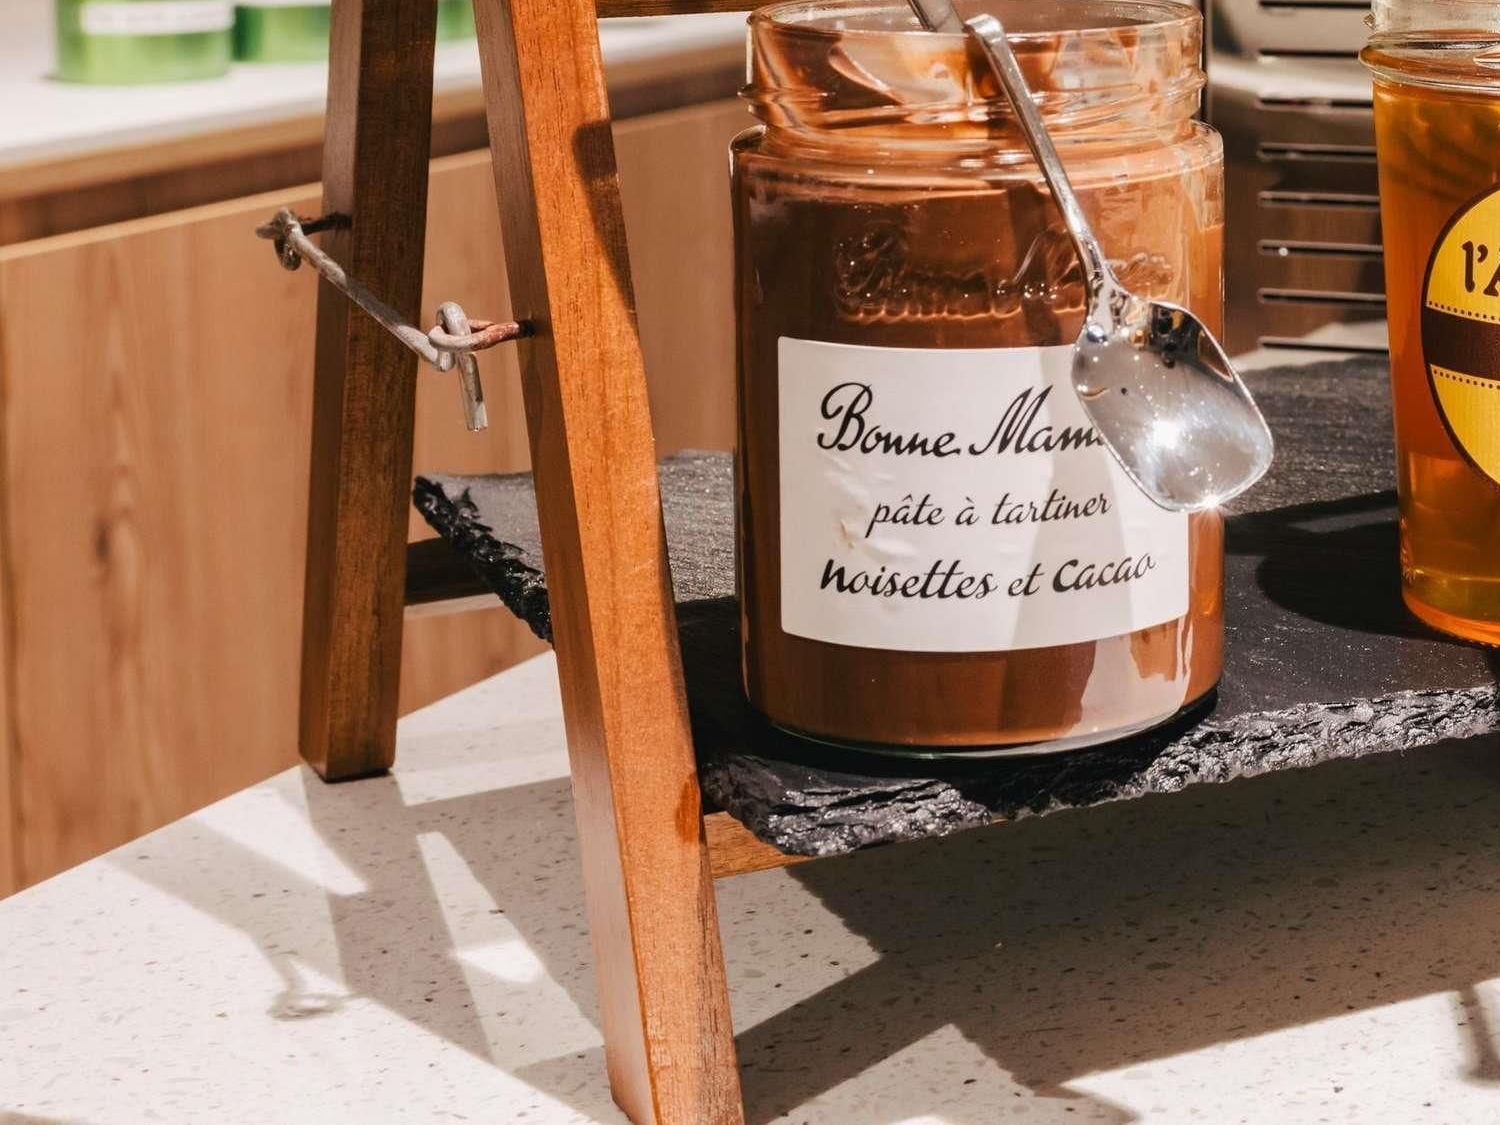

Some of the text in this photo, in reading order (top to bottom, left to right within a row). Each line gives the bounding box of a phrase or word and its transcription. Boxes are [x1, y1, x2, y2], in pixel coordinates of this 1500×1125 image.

[817, 382, 1106, 458] Bonne Mam
[865, 489, 1112, 539] pâte à tartiner
[1007, 565, 1044, 597] et
